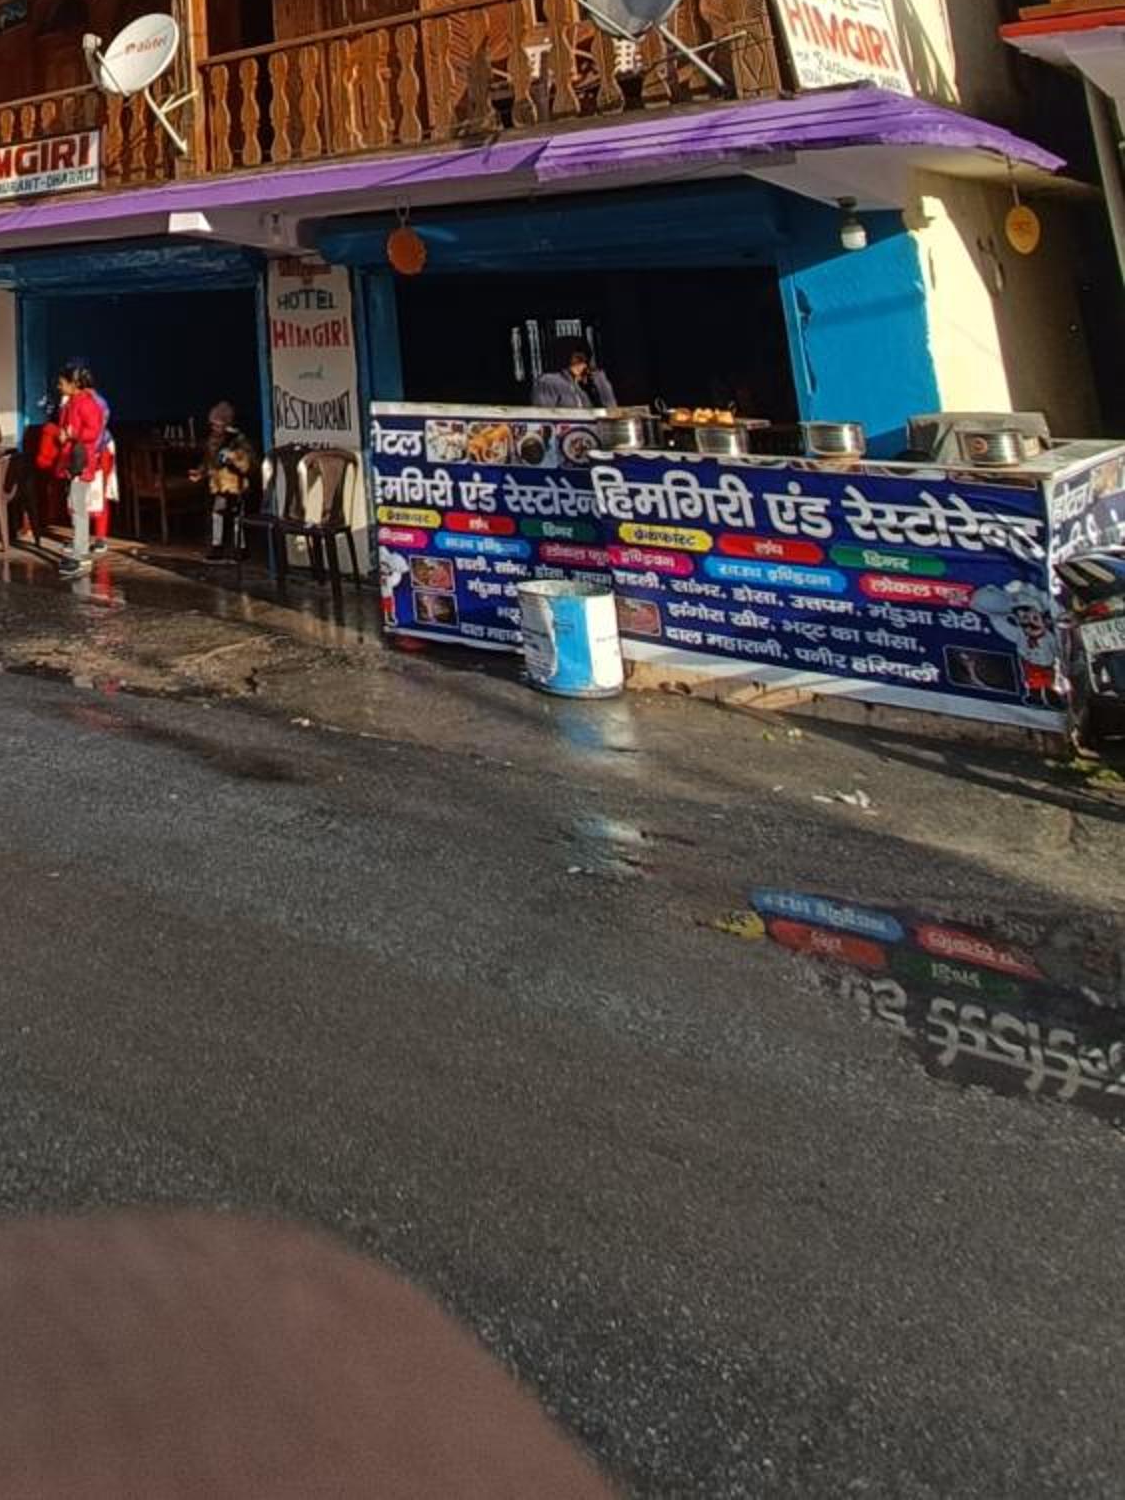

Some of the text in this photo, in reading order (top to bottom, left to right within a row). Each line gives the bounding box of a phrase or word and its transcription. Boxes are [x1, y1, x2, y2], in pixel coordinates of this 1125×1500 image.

[277, 289, 338, 310] HOTEL
[273, 317, 350, 348] HIMGIRI
[275, 386, 352, 432] RESTAURANT
[590, 465, 756, 528] हिमगिरी
[763, 482, 833, 539] एंड
[665, 625, 703, 646] दाल
[795, 647, 847, 670] पनीर
[831, 626, 859, 643] का
